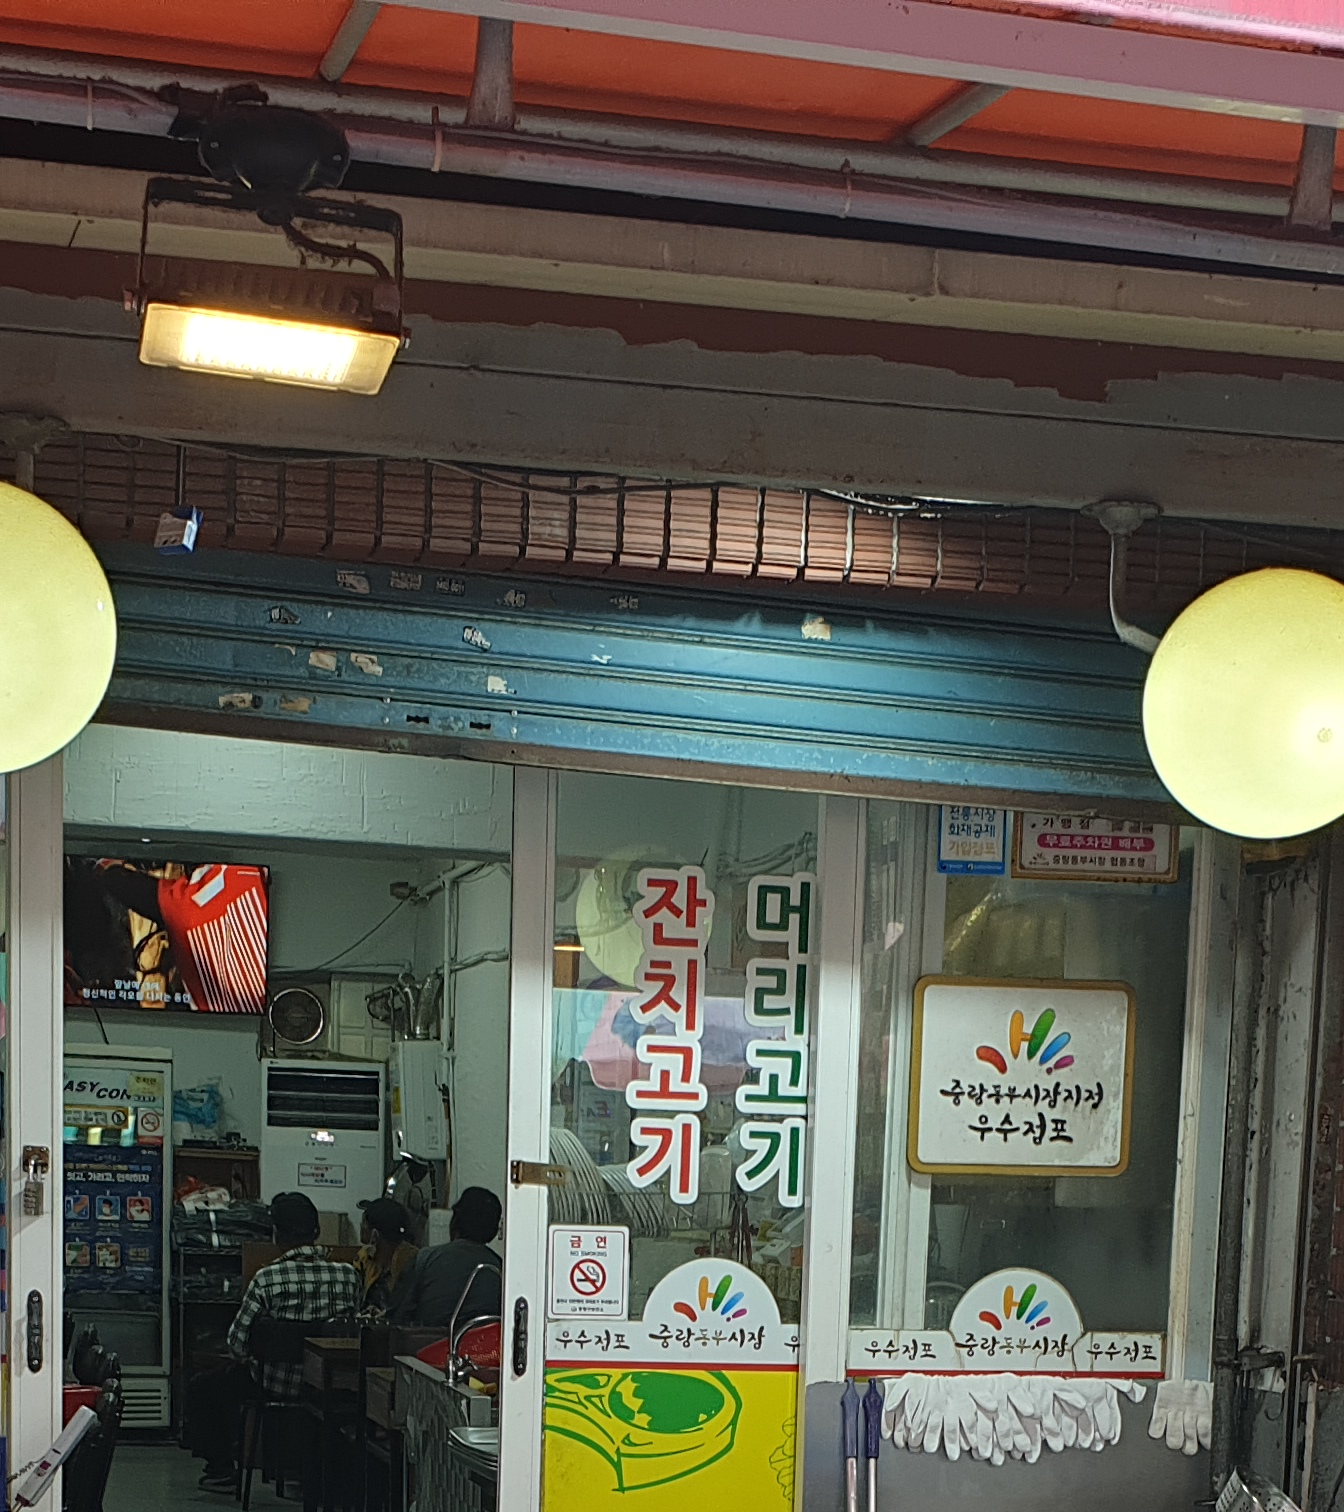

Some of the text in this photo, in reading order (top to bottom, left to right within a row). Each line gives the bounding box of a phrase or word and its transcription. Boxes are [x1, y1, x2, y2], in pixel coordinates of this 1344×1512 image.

[633, 872, 709, 1198] 잔치고기
[742, 878, 813, 1200] 머리고기
[968, 1111, 1074, 1146] 우수점포
[556, 1329, 631, 1351] 우수점포
[649, 1323, 766, 1350] 중랑동부시장
[864, 1338, 937, 1361] 우수점포
[955, 1332, 1069, 1357] 중랑동부시장
[1087, 1340, 1157, 1361] 우수점포
